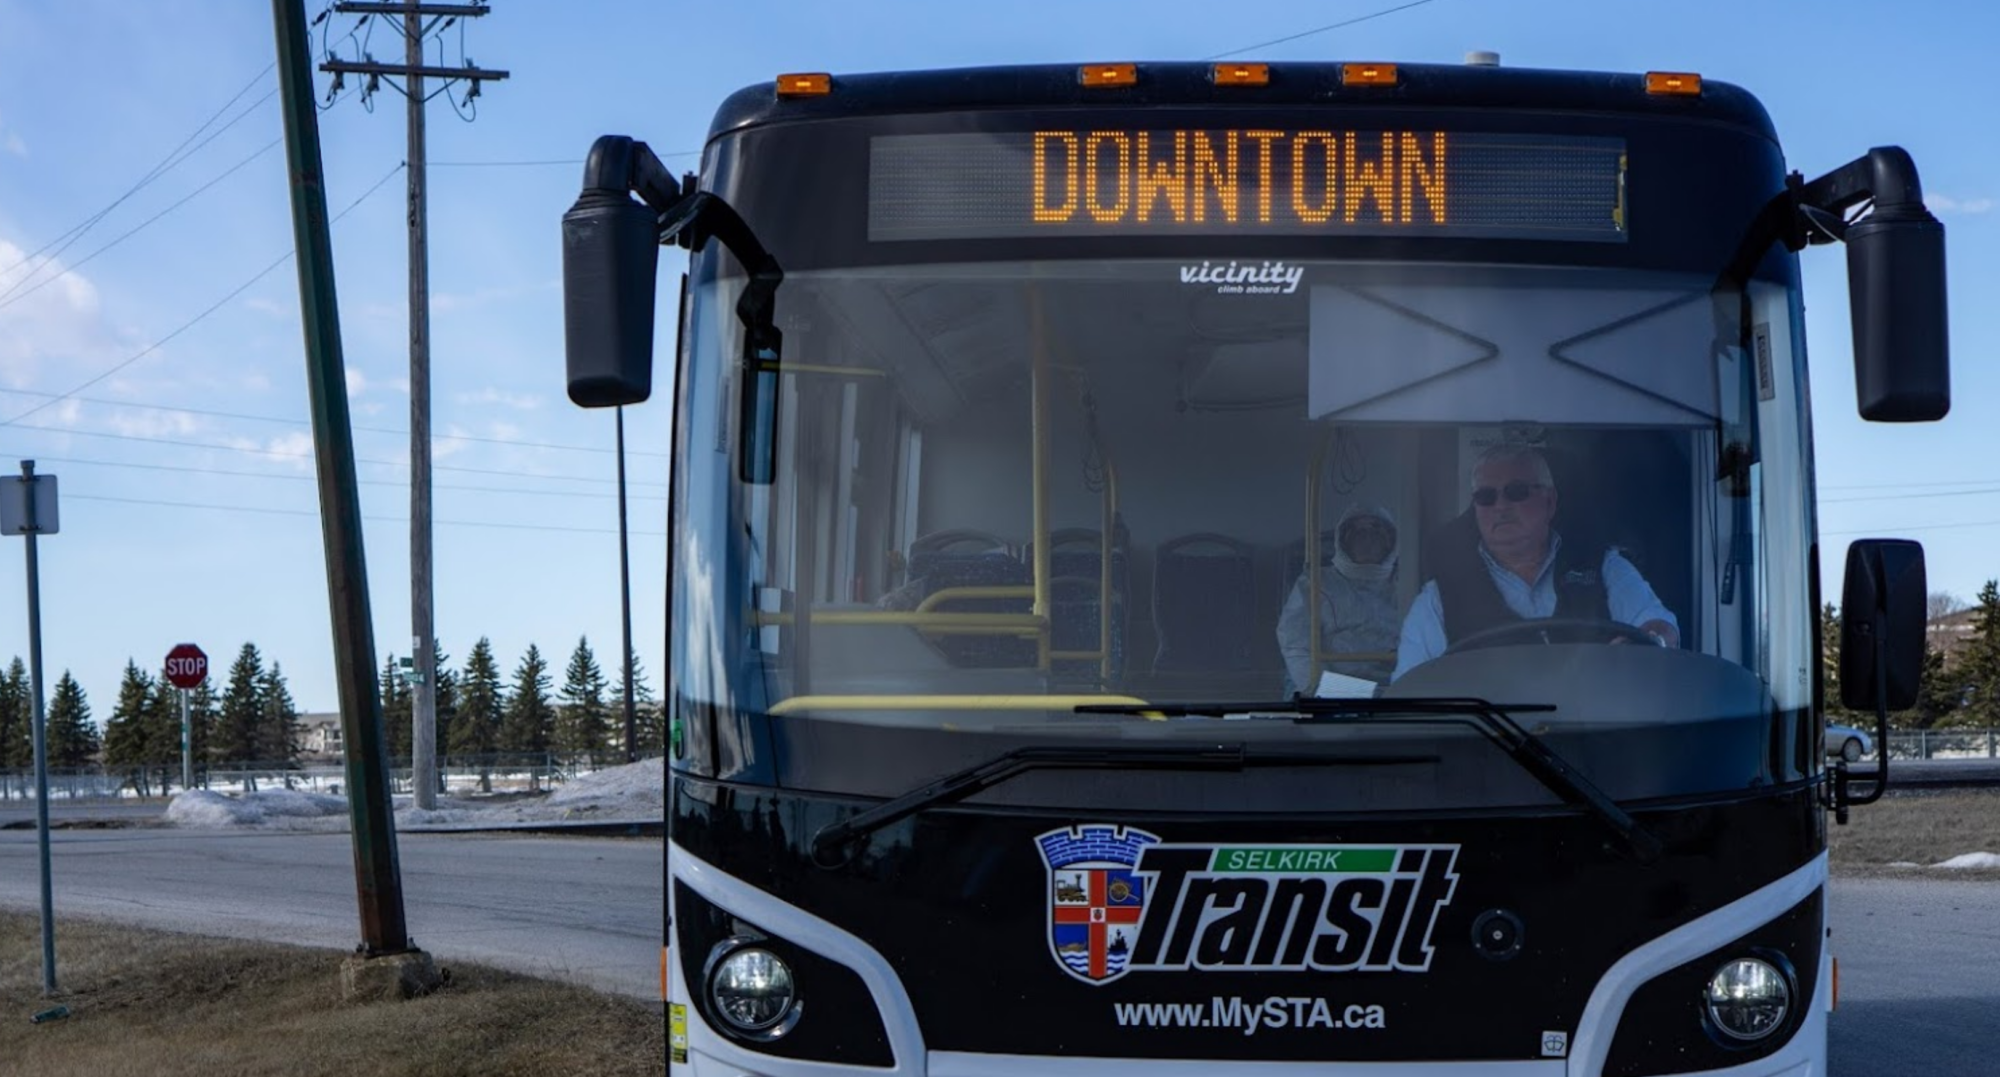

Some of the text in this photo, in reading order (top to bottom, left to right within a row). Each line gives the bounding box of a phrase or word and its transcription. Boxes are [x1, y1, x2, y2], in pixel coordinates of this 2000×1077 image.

[1032, 131, 1447, 223] DOWNTOWN
[1180, 261, 1304, 294] vicinity
[1217, 285, 1281, 294] climb aboard
[167, 657, 206, 676] STOP
[1228, 851, 1339, 870] SELKIRK
[1129, 844, 1461, 972] Transit
[1114, 997, 1386, 1035] www.MySTA.ca
